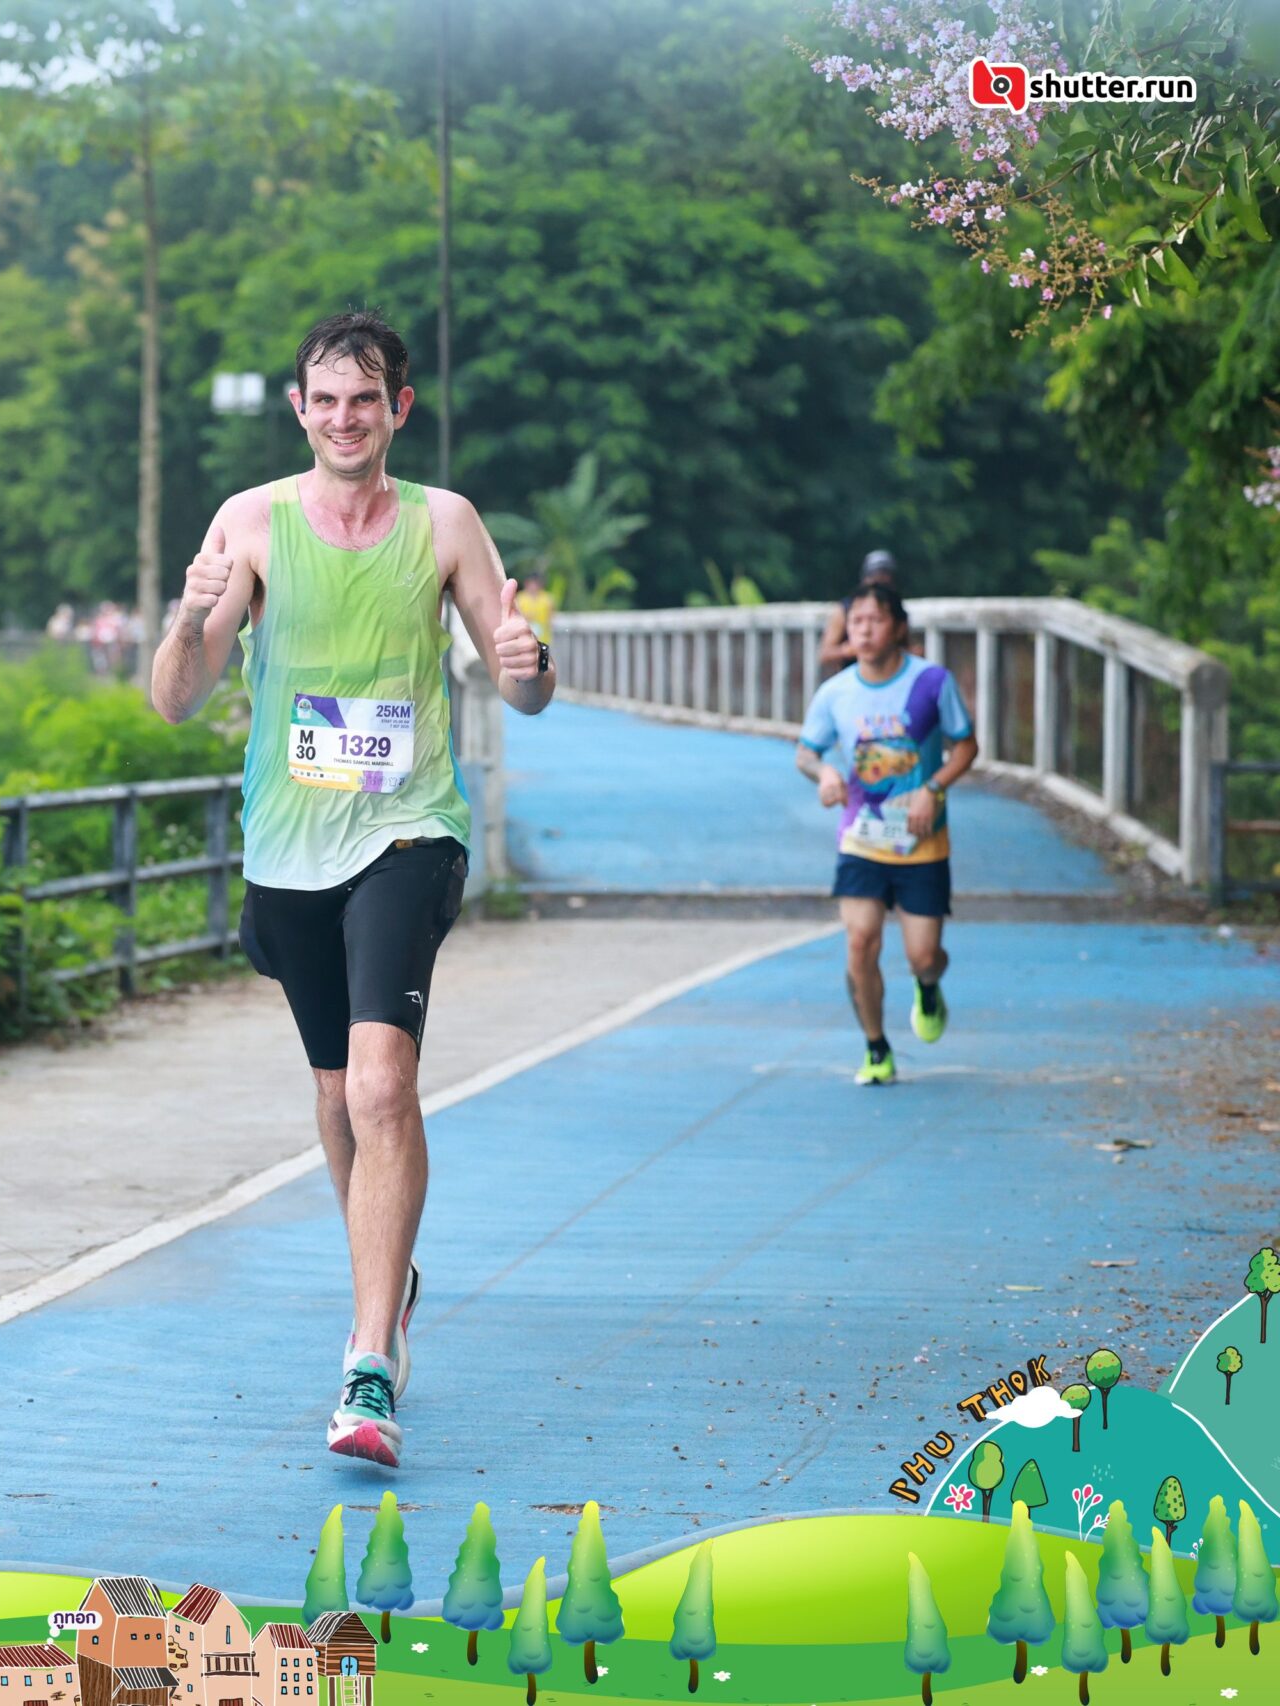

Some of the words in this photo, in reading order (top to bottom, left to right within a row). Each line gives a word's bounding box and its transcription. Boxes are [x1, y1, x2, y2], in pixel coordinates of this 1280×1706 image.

[376, 705, 410, 718] 25KM
[299, 730, 314, 745] M
[296, 745, 316, 760] 30
[338, 734, 391, 758] 1329
